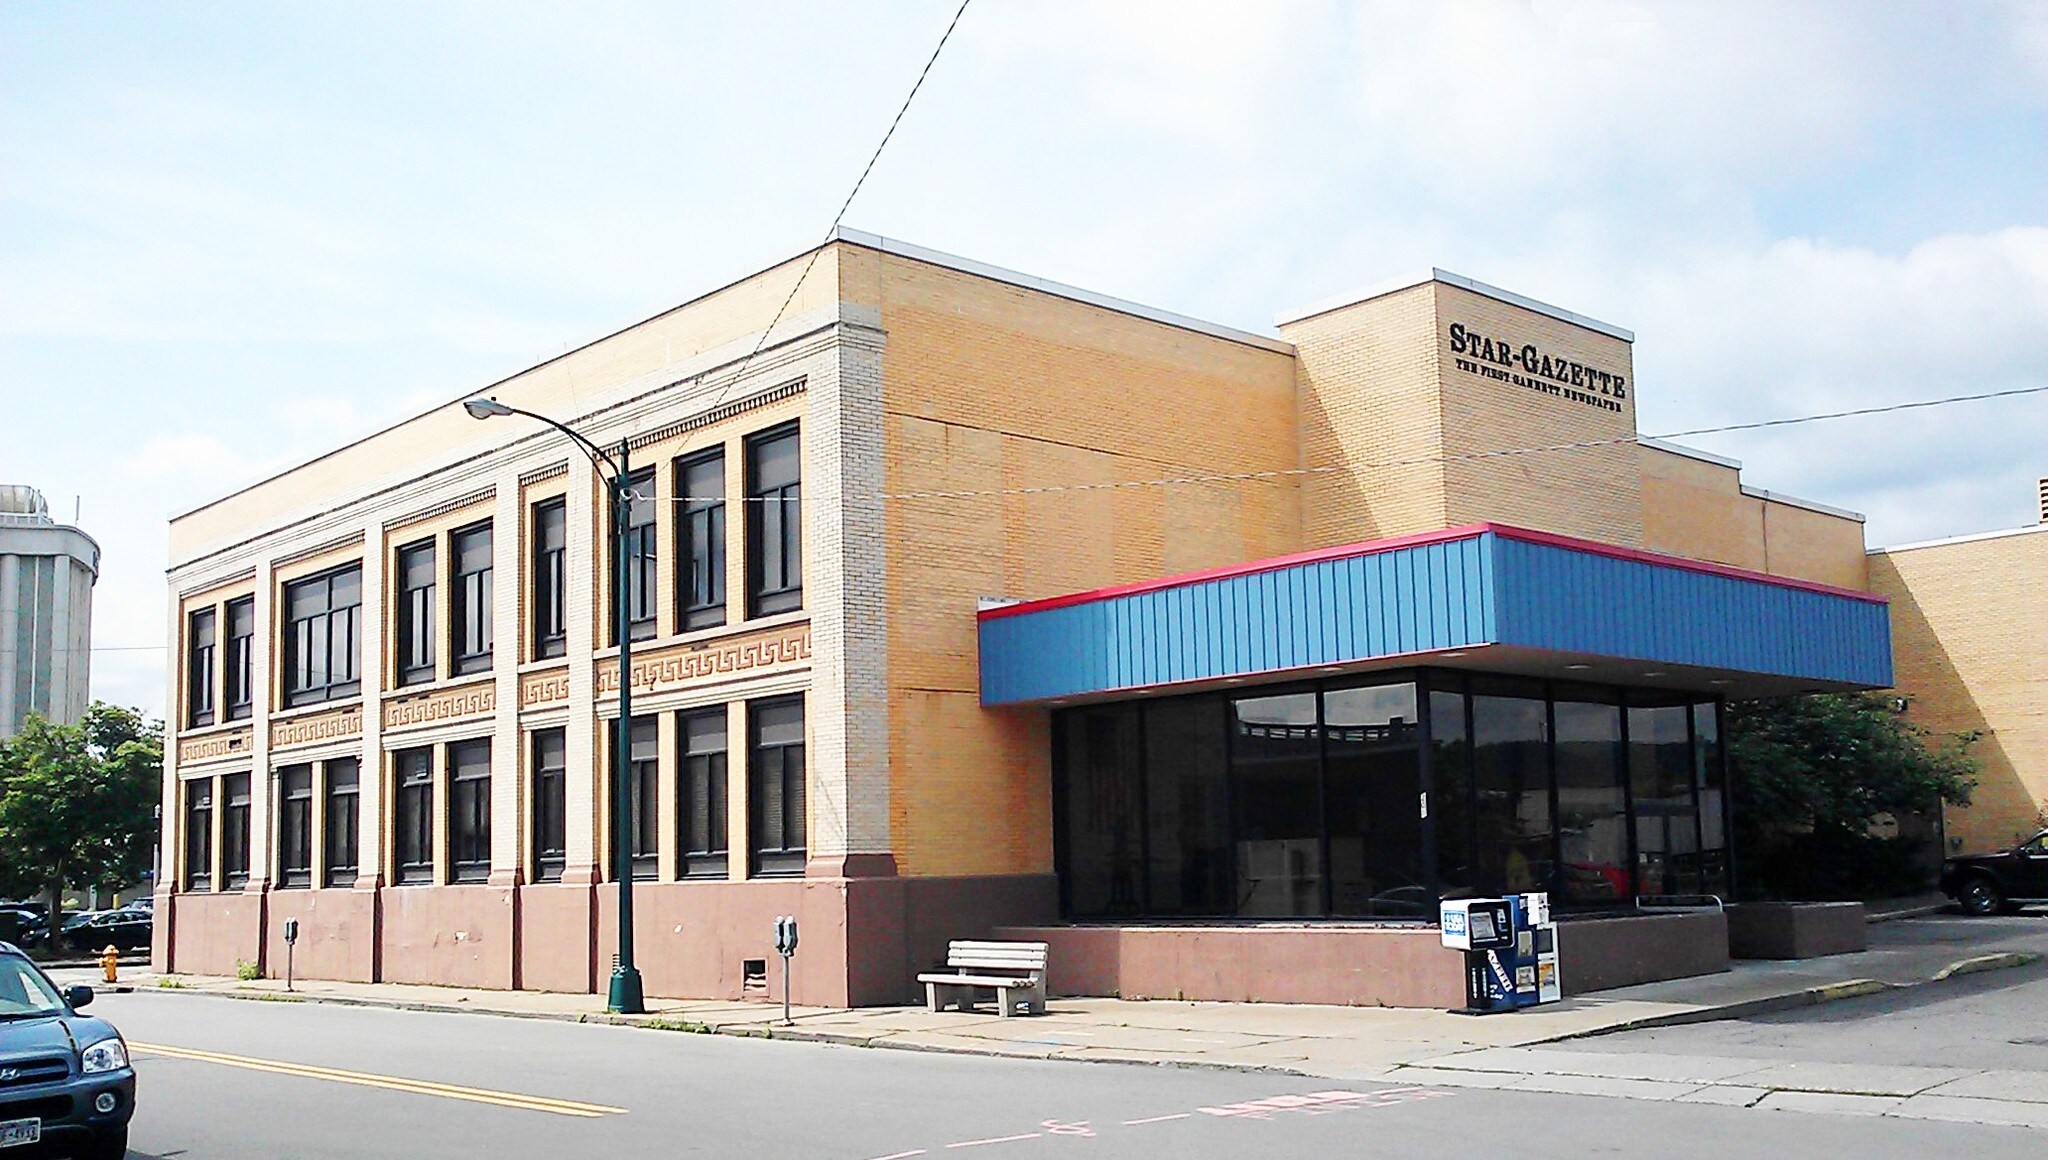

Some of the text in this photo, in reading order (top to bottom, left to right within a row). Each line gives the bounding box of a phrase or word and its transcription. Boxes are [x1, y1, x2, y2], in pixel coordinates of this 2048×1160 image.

[1450, 323, 1626, 399] STAR-GAZETTE
[1456, 358, 1622, 412] THE FIRST GANNETT NEWSPAPER
